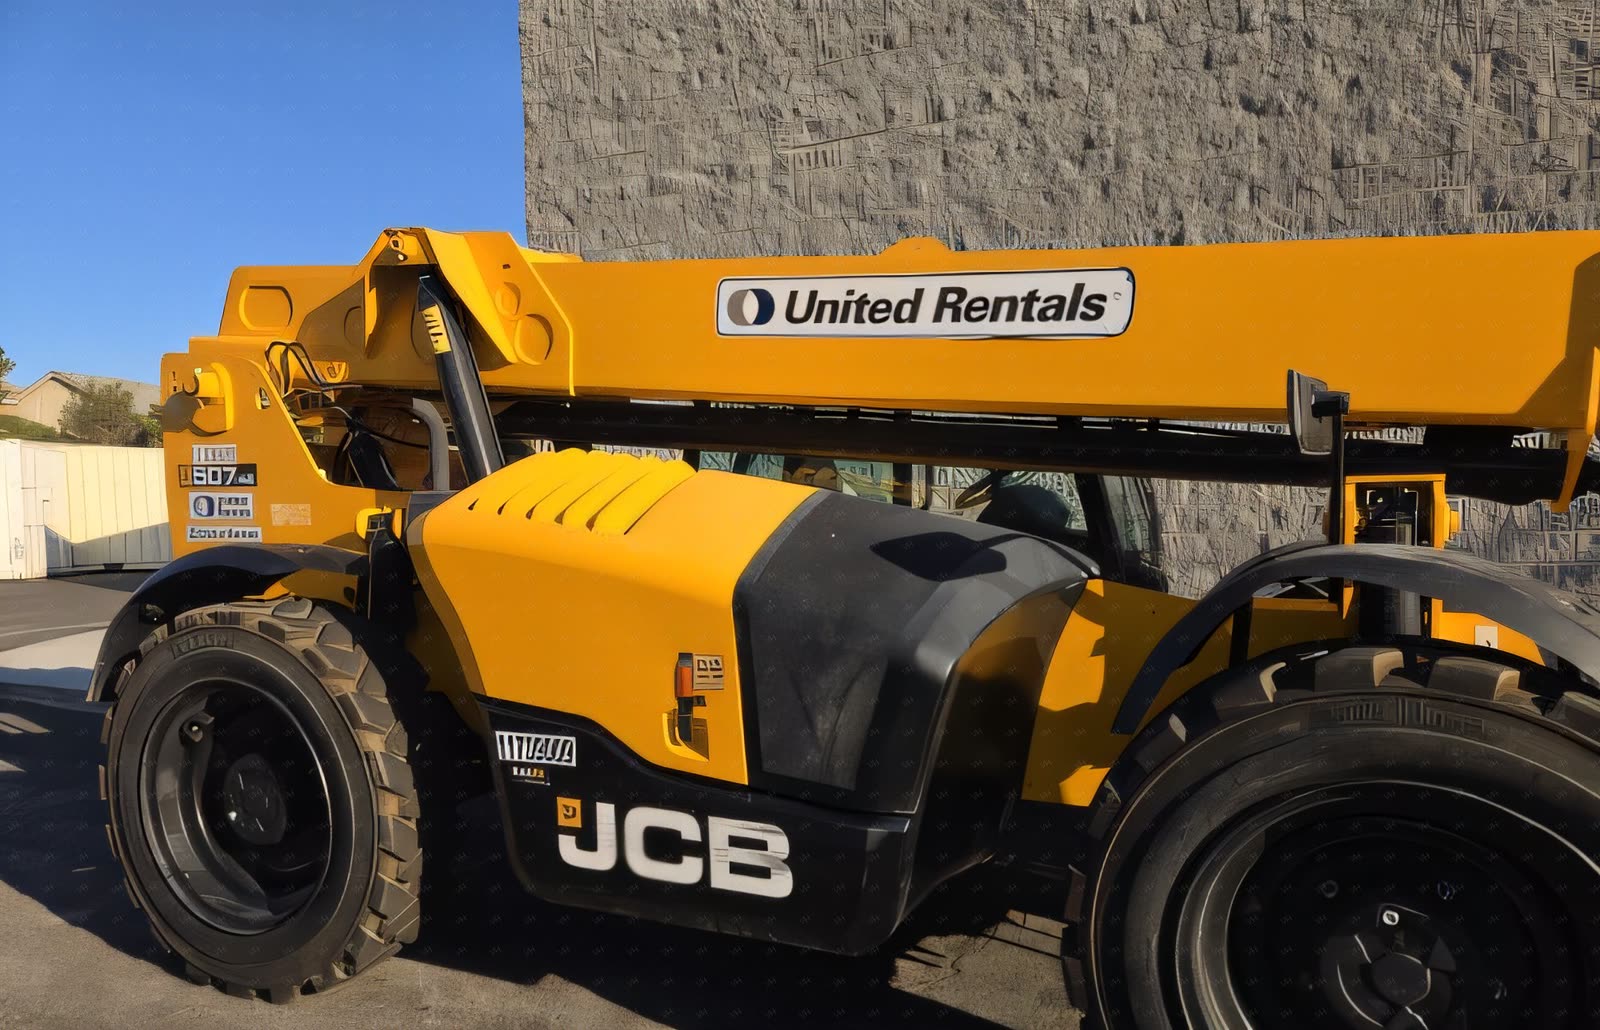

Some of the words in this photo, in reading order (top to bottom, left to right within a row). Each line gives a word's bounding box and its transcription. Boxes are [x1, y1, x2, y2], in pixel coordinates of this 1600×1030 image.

[785, 288, 924, 324] United
[933, 282, 1107, 323] Rentals
[558, 801, 793, 898] JCB
